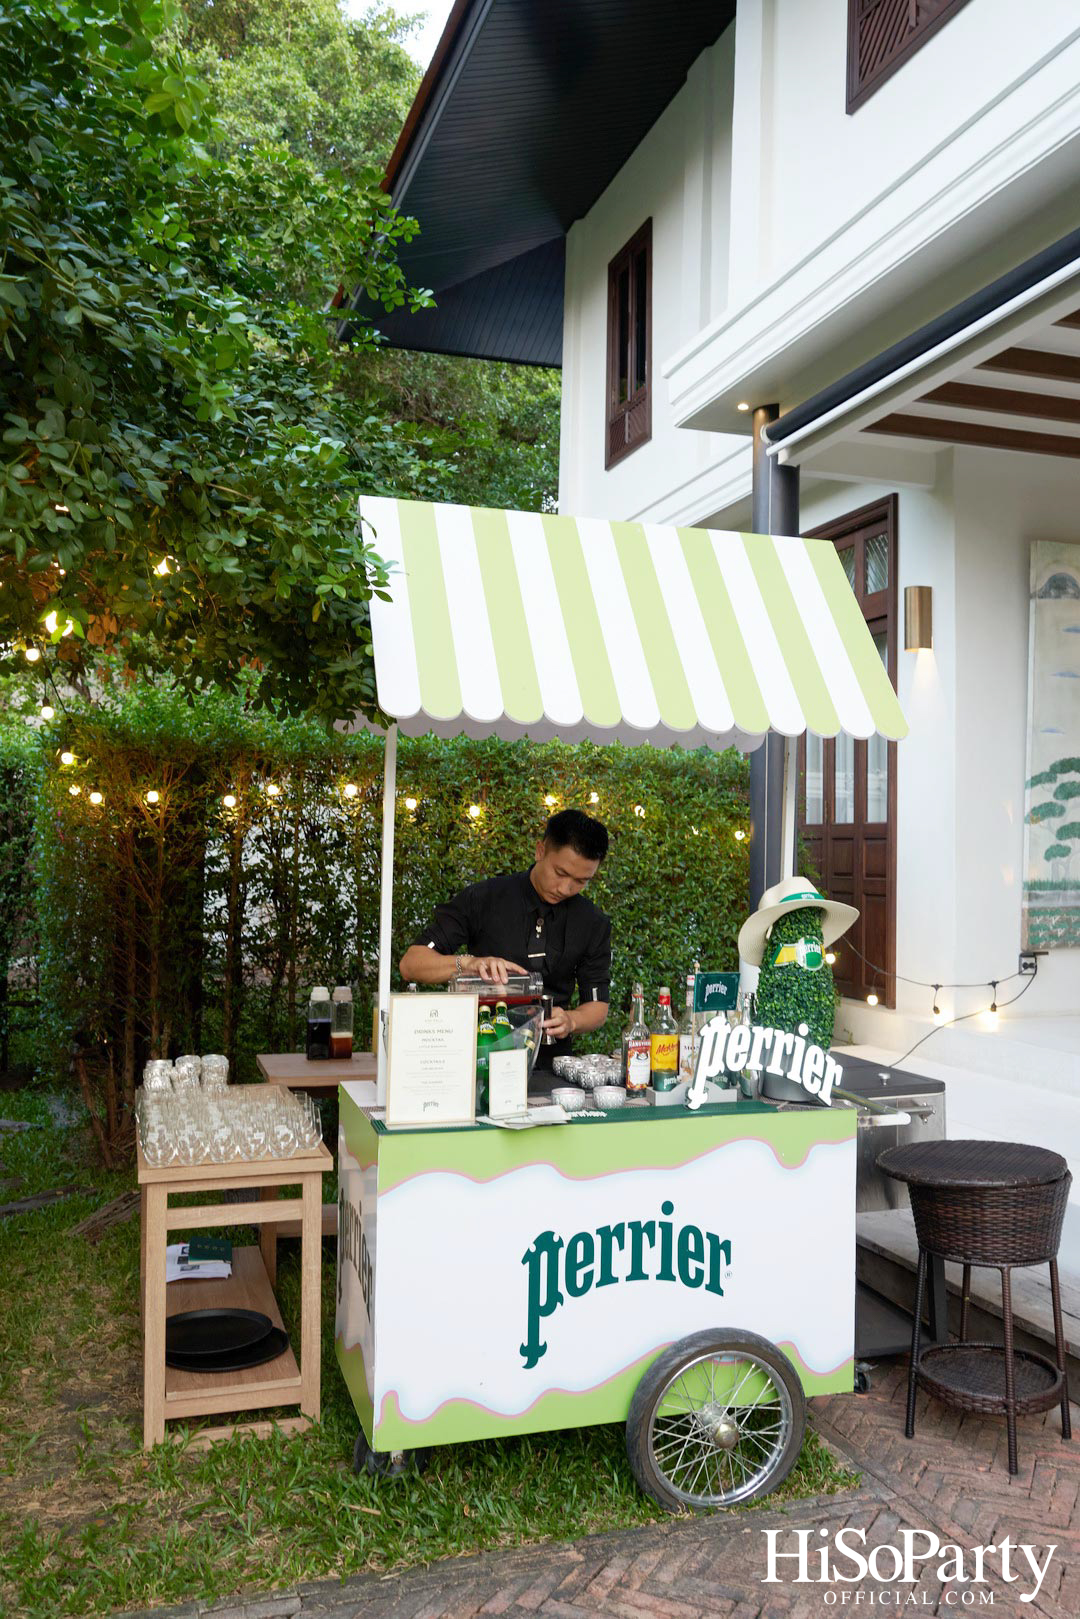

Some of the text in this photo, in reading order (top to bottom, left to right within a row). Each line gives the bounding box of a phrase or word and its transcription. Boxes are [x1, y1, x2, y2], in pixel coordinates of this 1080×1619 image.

[704, 981, 728, 1003] perrier
[687, 1016, 843, 1110] perrier
[519, 1200, 732, 1370] perrier
